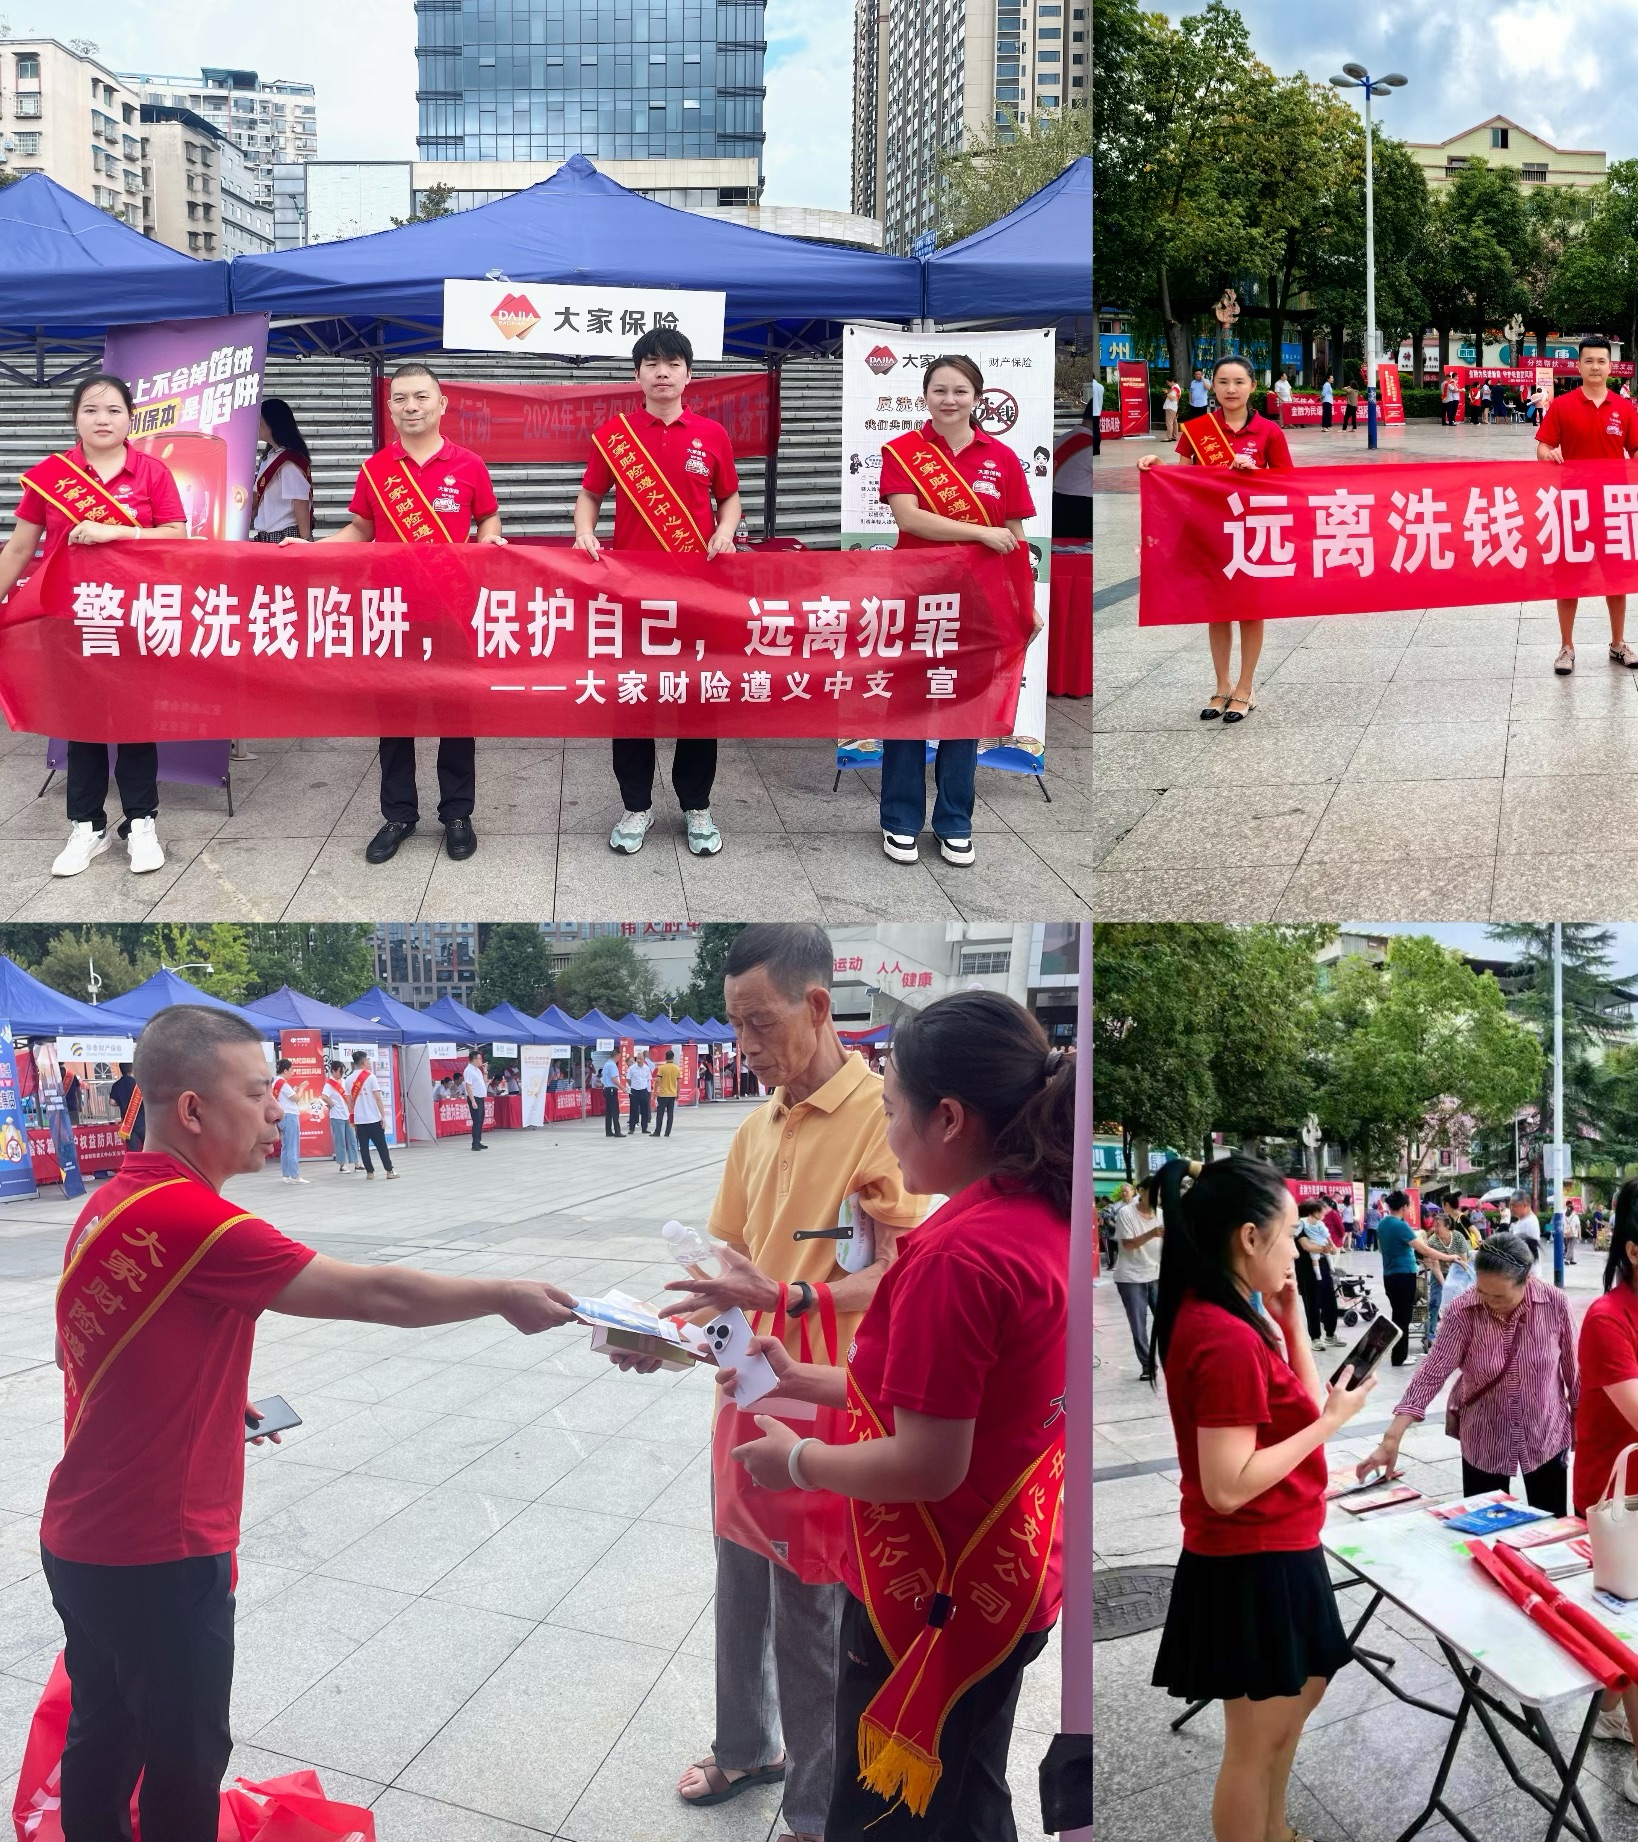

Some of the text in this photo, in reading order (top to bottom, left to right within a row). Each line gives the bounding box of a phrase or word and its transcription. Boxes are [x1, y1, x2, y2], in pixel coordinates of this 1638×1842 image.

[498, 310, 536, 321] DAJIA
[554, 306, 680, 336] 大家保险
[869, 356, 896, 366] DAJIA
[988, 357, 1032, 368] 财产保险
[126, 346, 254, 404] 上不会掉馅饼
[607, 432, 700, 553] 大家财险遵义中心支公
[384, 474, 434, 544] 大家财险遵
[925, 667, 958, 699] 宣
[833, 956, 902, 974] 运动 人人
[902, 972, 933, 988] 健康
